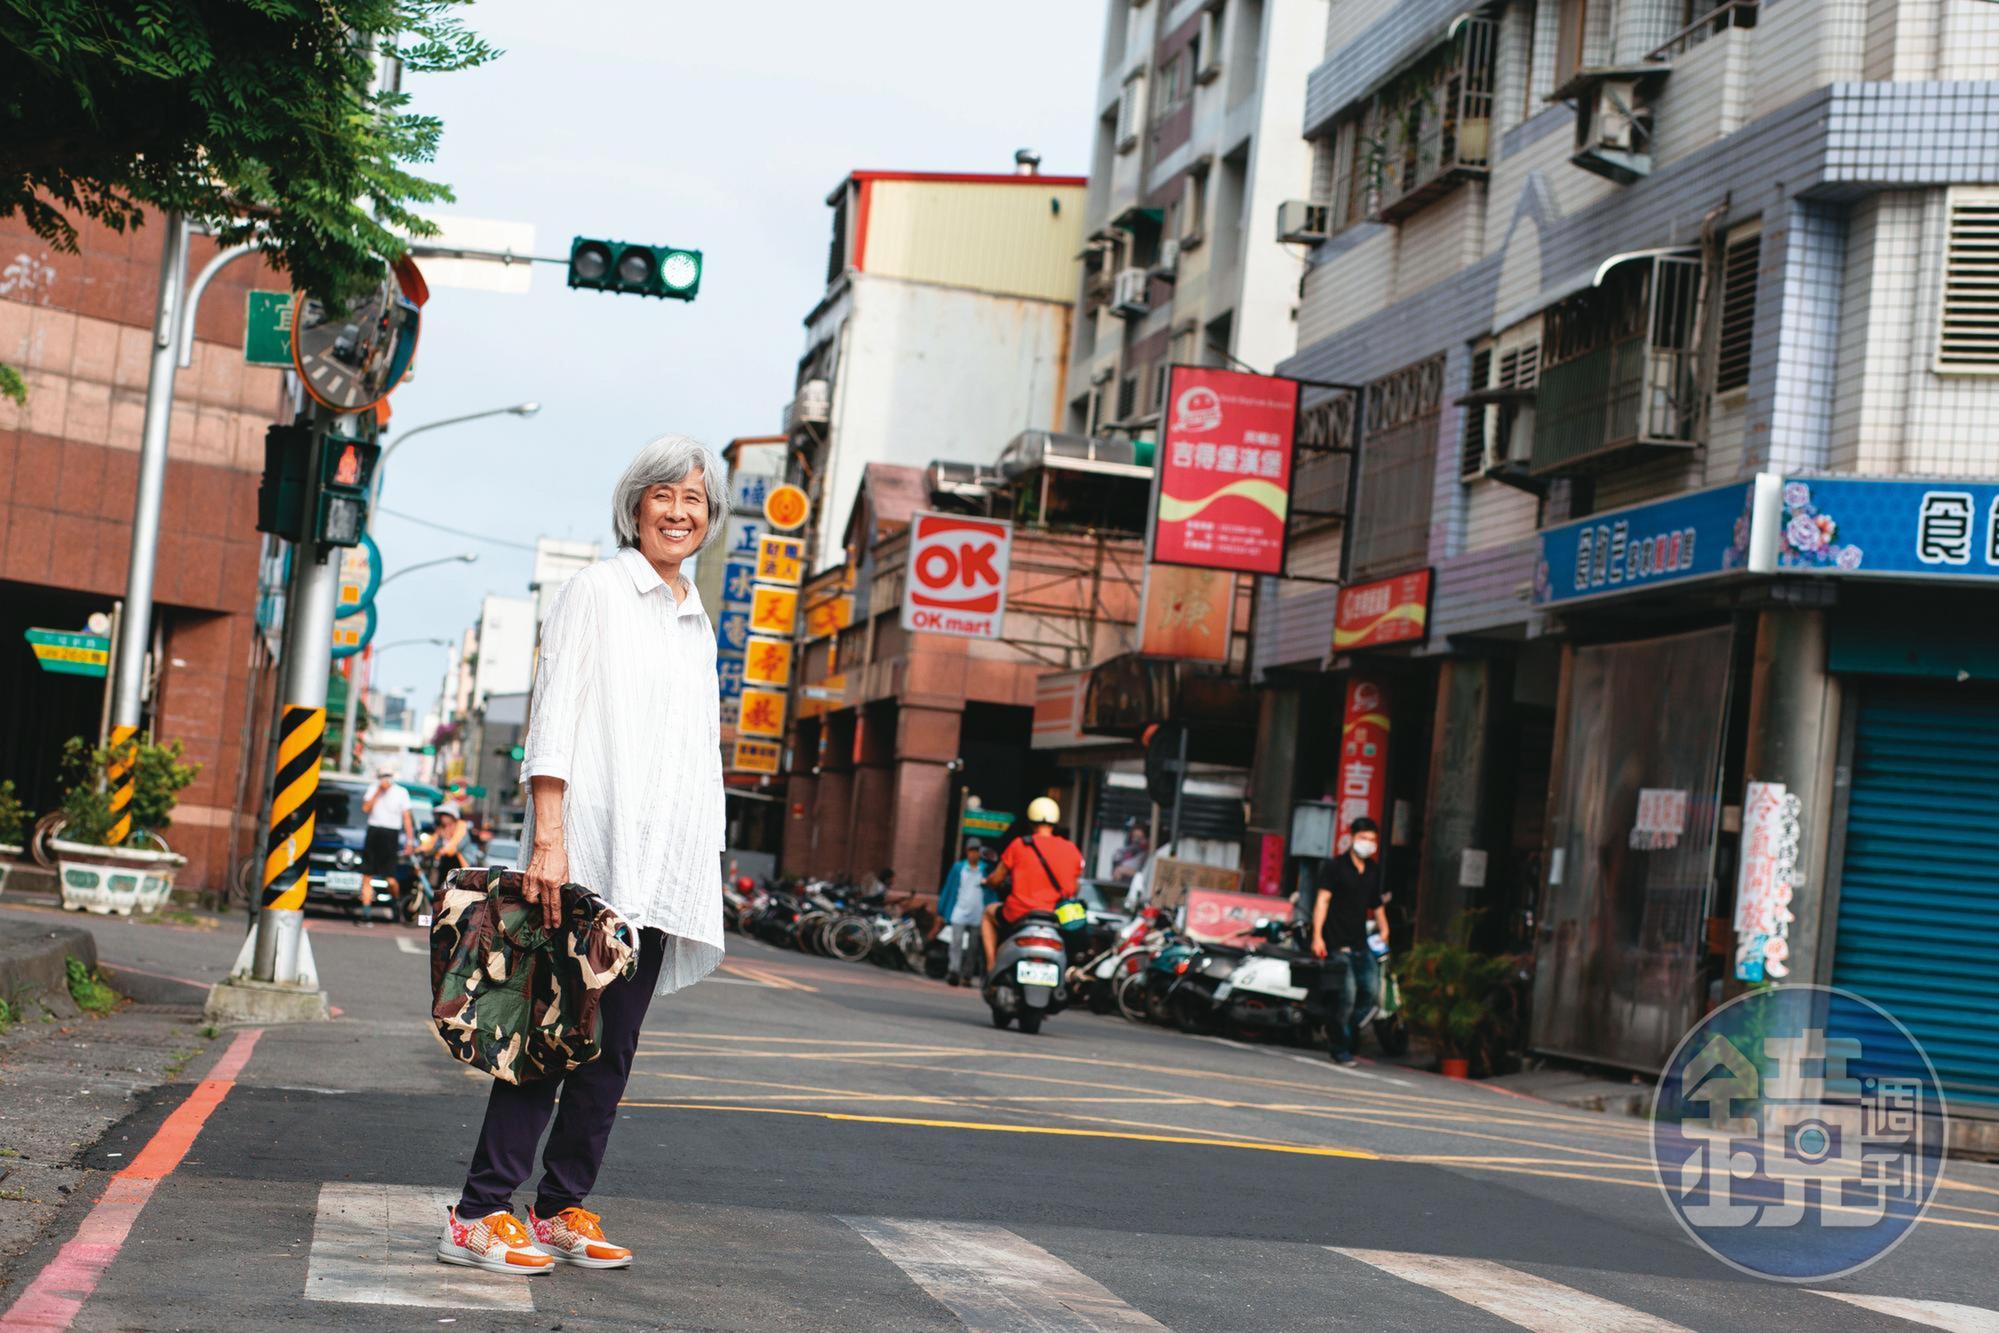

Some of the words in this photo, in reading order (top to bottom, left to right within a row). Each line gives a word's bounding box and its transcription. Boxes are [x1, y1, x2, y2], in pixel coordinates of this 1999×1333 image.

[914, 541, 1001, 590] OK
[912, 610, 943, 630] OK
[946, 617, 991, 637] mart
